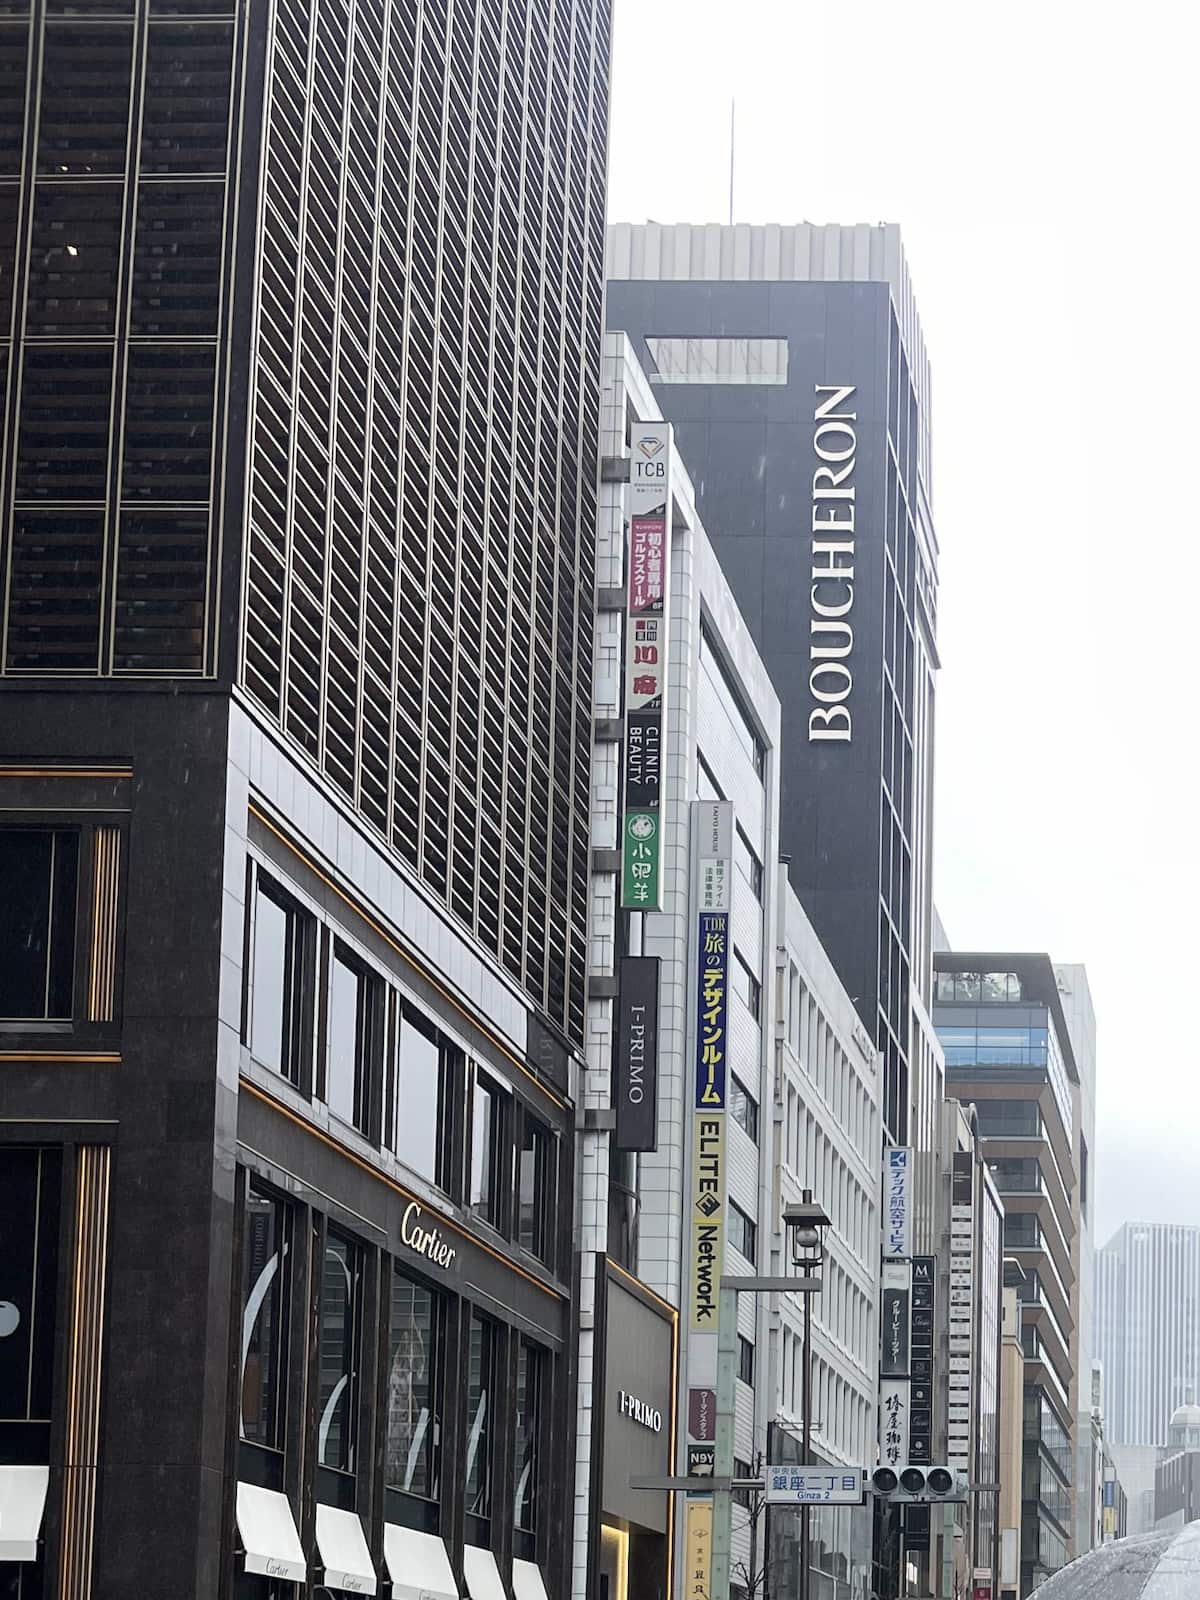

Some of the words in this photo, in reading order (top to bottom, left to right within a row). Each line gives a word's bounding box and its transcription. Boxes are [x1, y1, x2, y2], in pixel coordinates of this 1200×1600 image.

[635, 462, 665, 477] TCB
[808, 384, 857, 742] BOUCHERON
[629, 727, 642, 784] BEAUTY
[645, 726, 658, 784] CLINIC
[704, 917, 725, 931] TDR
[700, 933, 725, 1104] 旅のデザインルーム
[629, 1005, 645, 1104] I-PRIMO
[700, 1121, 719, 1192] ELITE
[401, 1202, 456, 1269] Cartier
[697, 1225, 718, 1322] Network.
[619, 1390, 662, 1433] I-PRIMO
[691, 1453, 714, 1463] N9Y
[773, 1476, 855, 1490] 銀座二丁目
[797, 1491, 821, 1499] Ginza
[824, 1491, 830, 1499] 2
[266, 1558, 288, 1576] Cartier
